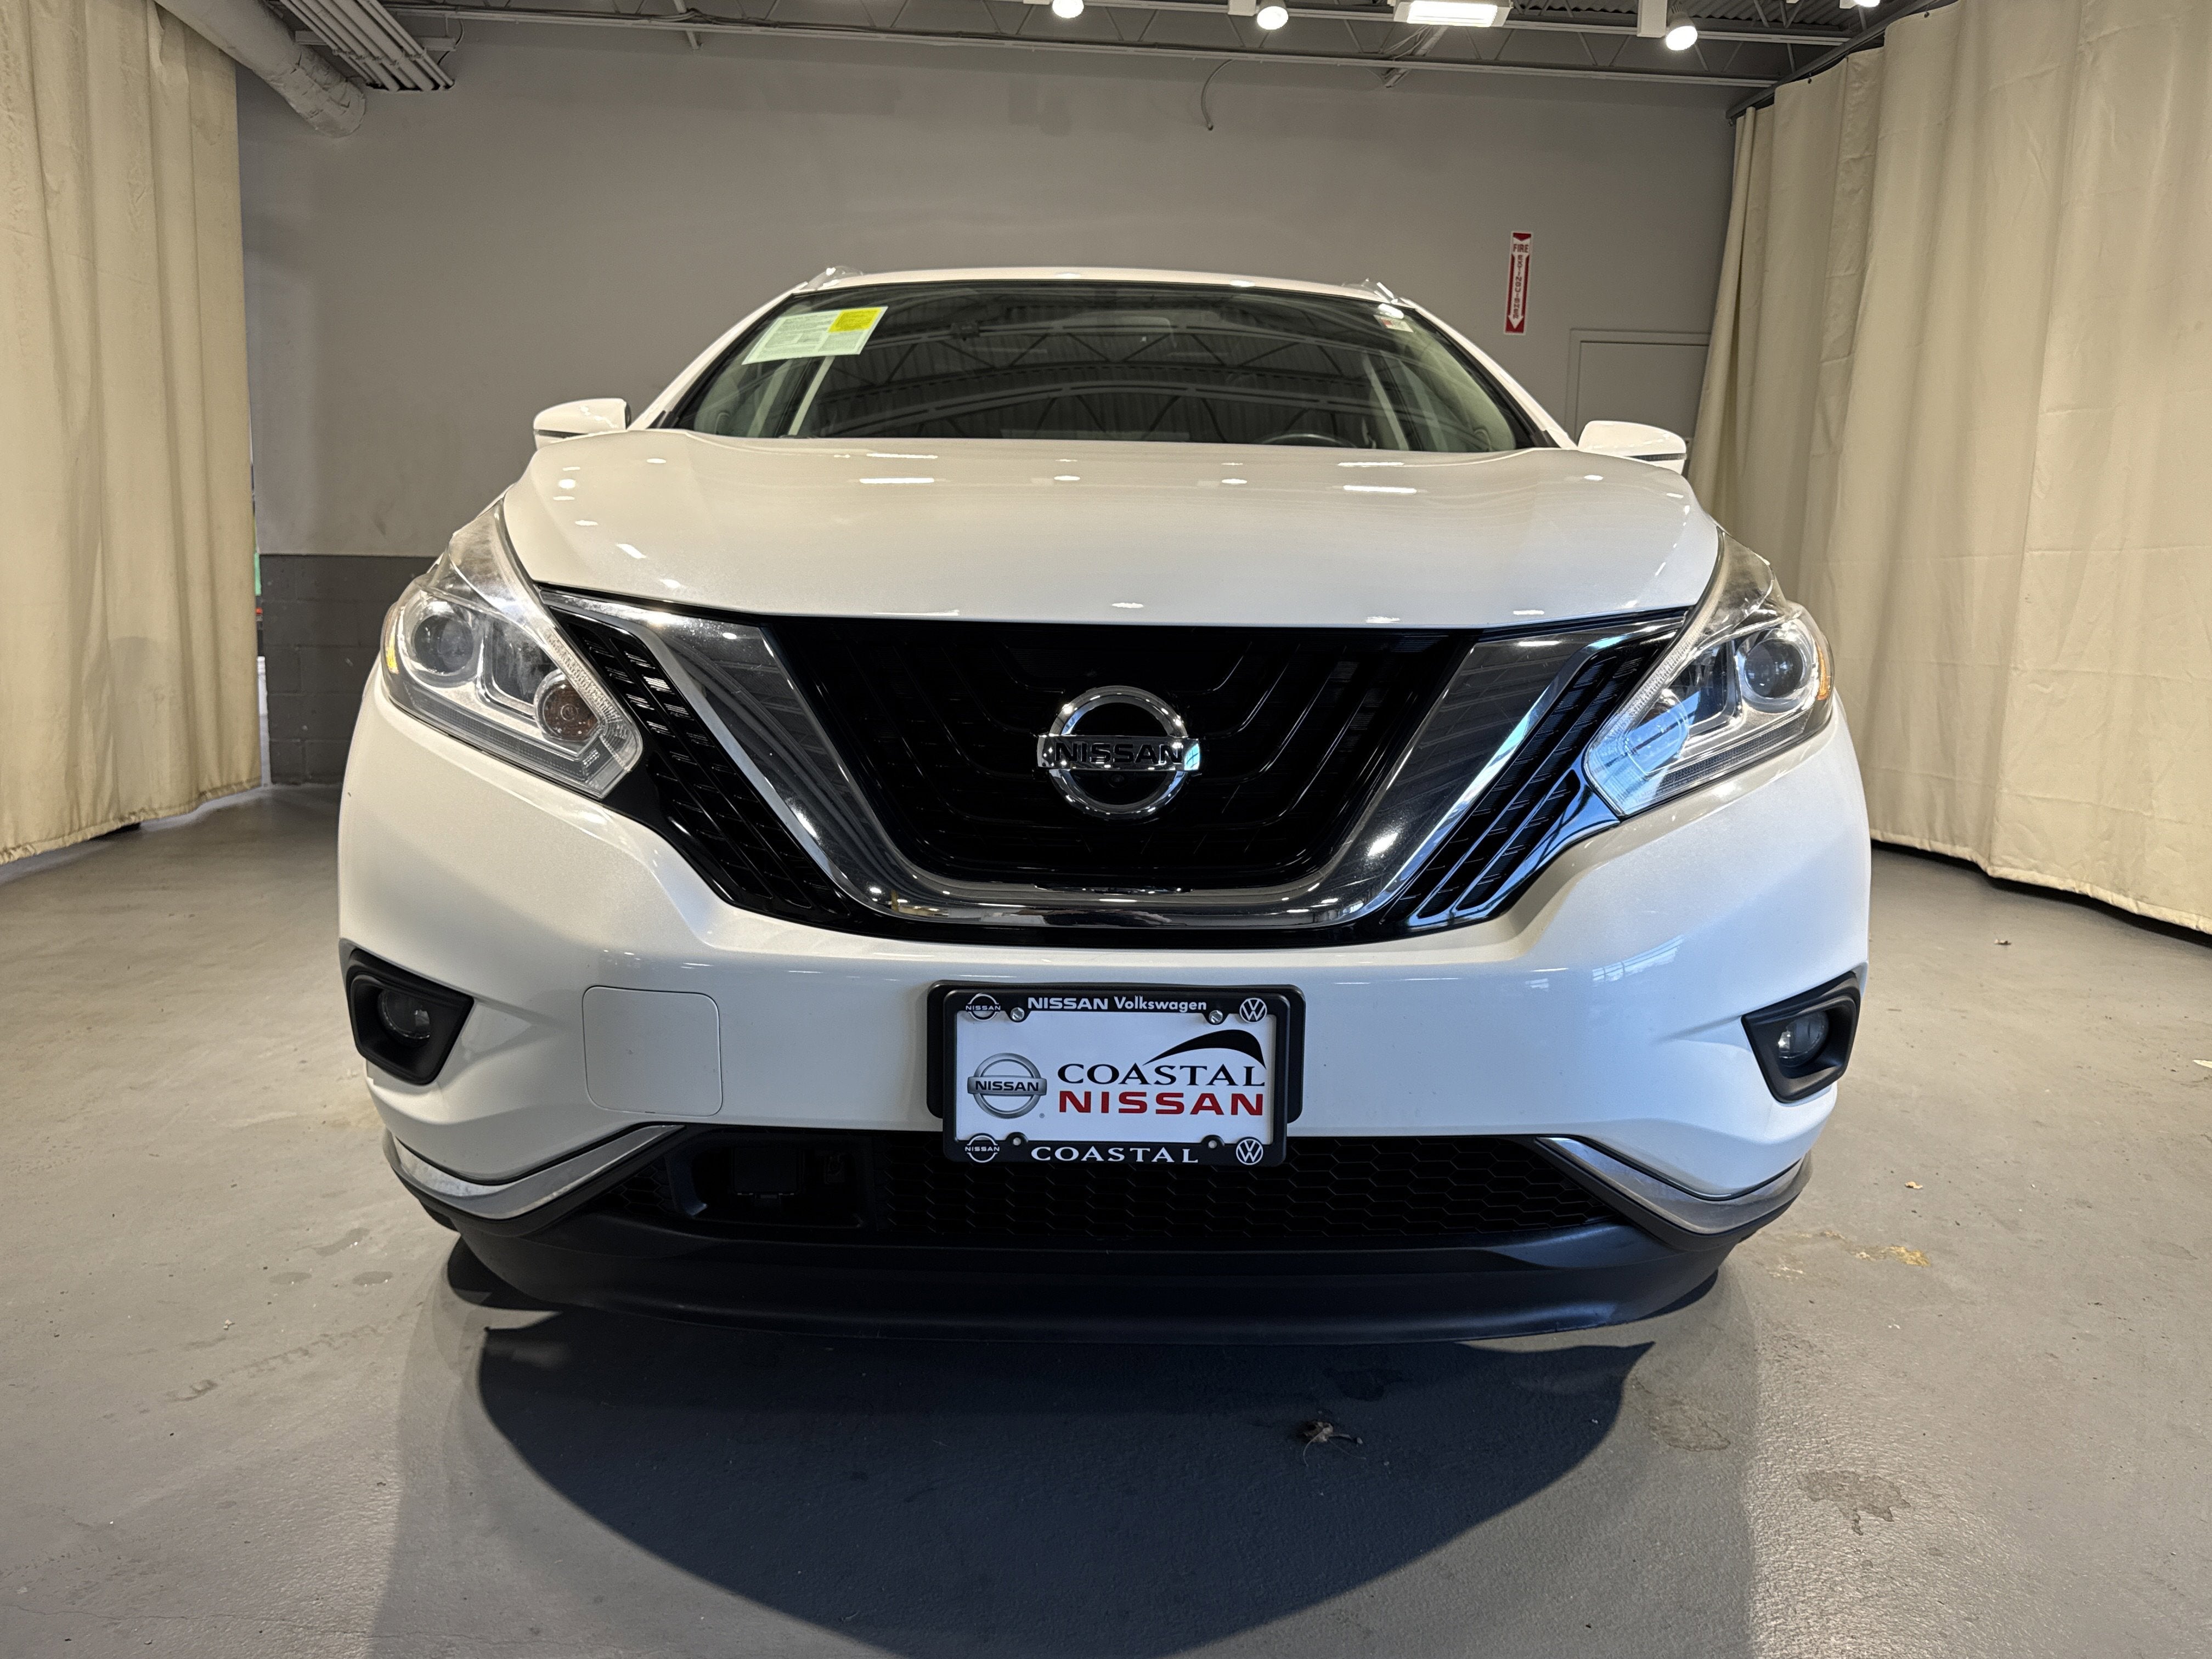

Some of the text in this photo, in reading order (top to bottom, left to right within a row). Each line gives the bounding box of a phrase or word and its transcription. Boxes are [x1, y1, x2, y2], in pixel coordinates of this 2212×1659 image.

[1513, 244, 1529, 253] FIRE
[1513, 255, 1523, 319] EXTINGUISHER
[1055, 742, 1182, 765] NISSAN
[1028, 995, 1207, 1013] NISSAN Volkswagen
[1057, 1063, 1266, 1087] COASTAL
[975, 1080, 1039, 1092] NISSAN
[1059, 1091, 1263, 1116] NISSAN
[1030, 1146, 1199, 1164] COASTAL
